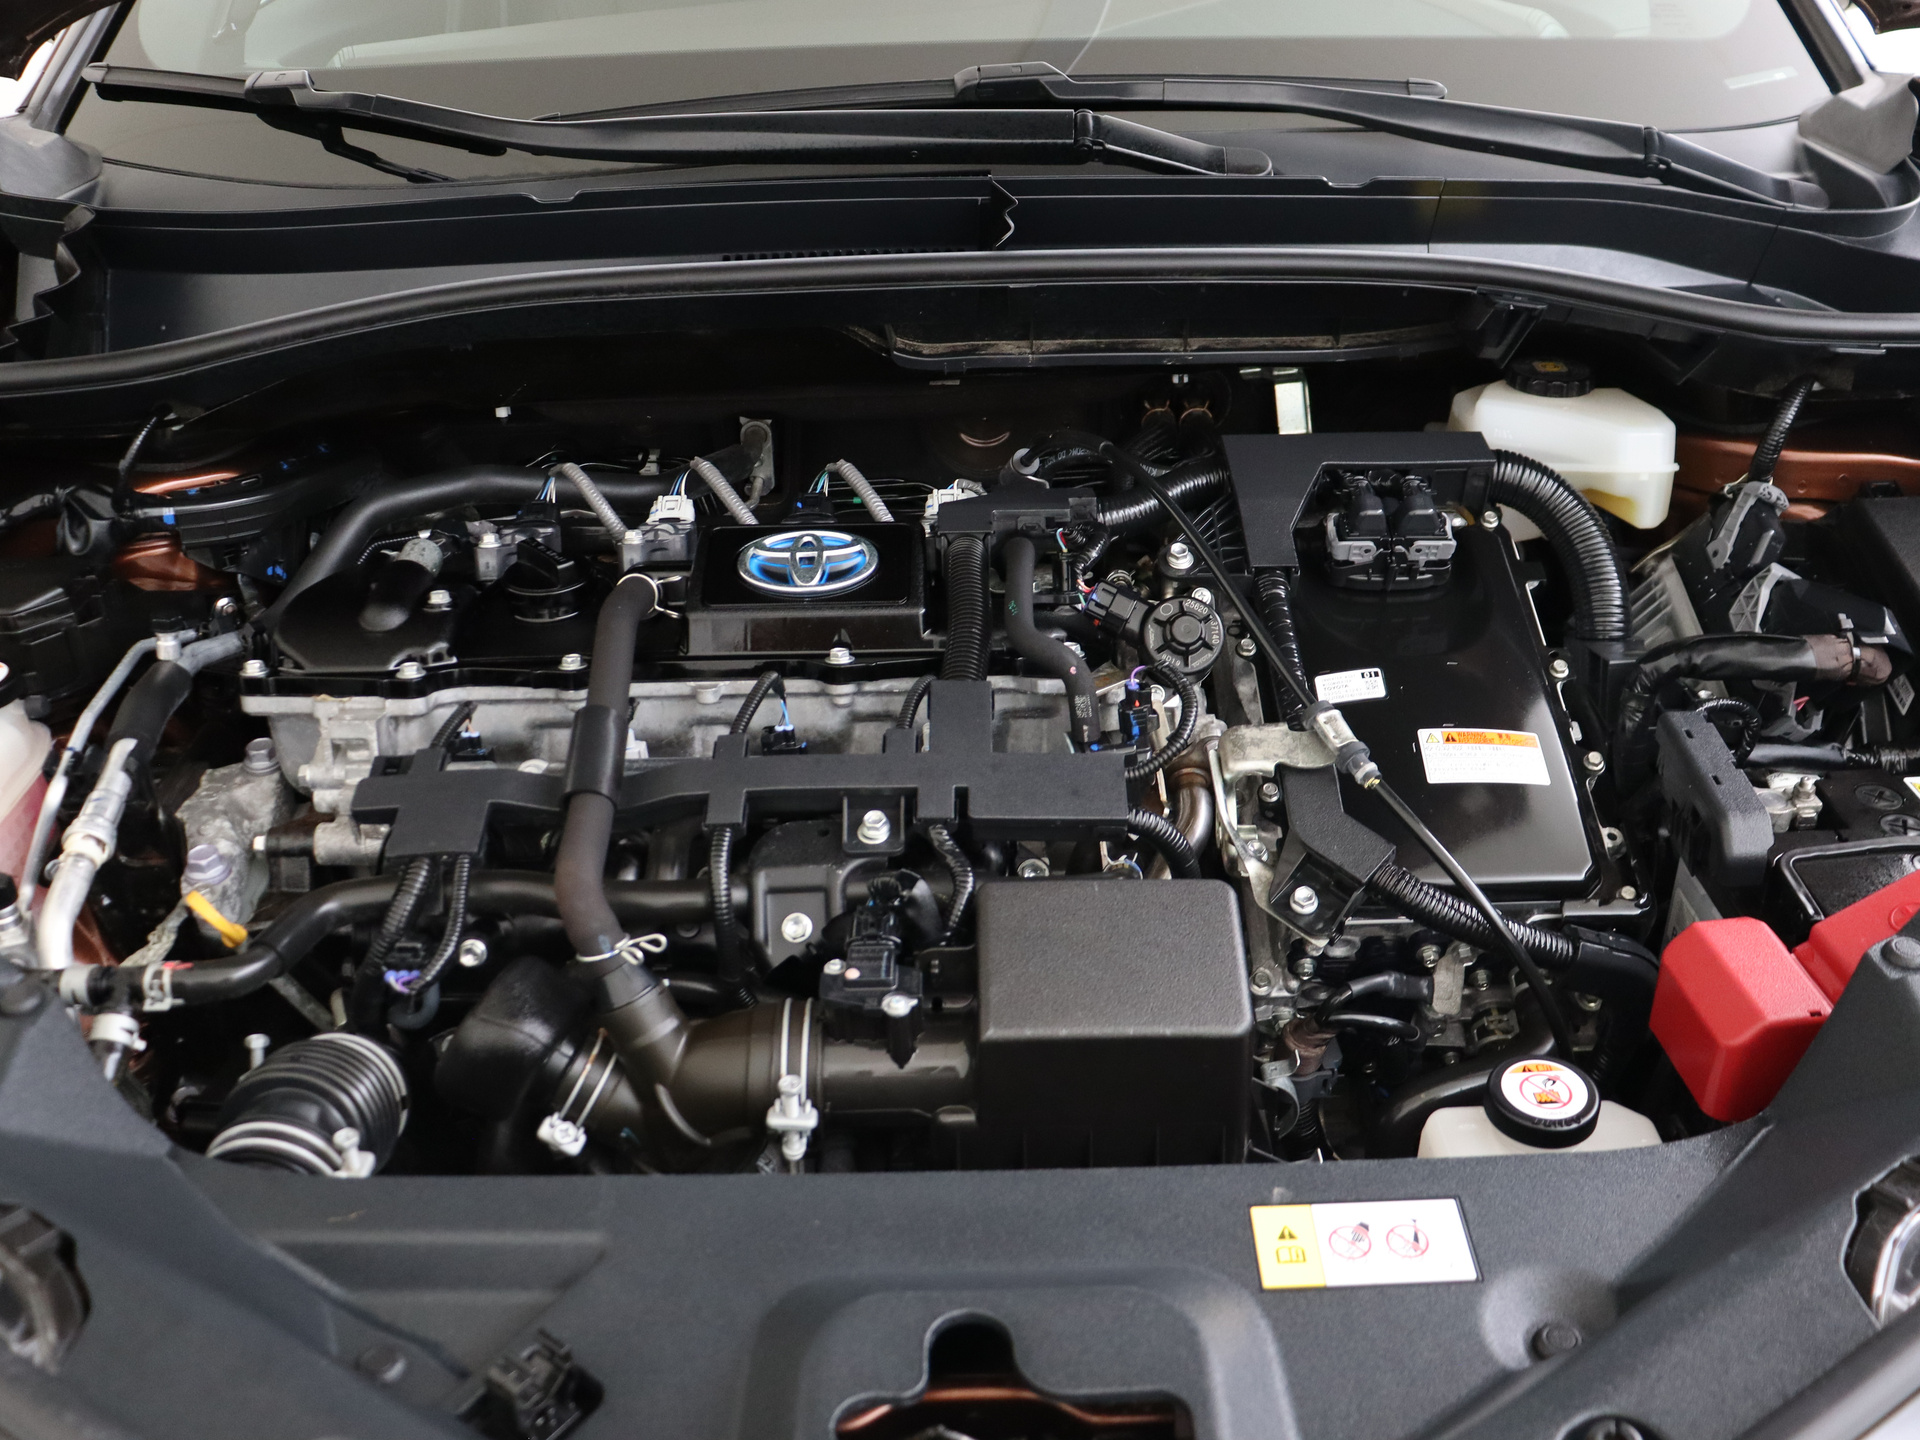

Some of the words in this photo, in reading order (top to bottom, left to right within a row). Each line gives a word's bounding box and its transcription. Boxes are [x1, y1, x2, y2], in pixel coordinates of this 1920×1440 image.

[1185, 599, 1208, 614] 25620
[1211, 621, 1219, 644] 37140
[1457, 731, 1487, 739] WARNING
